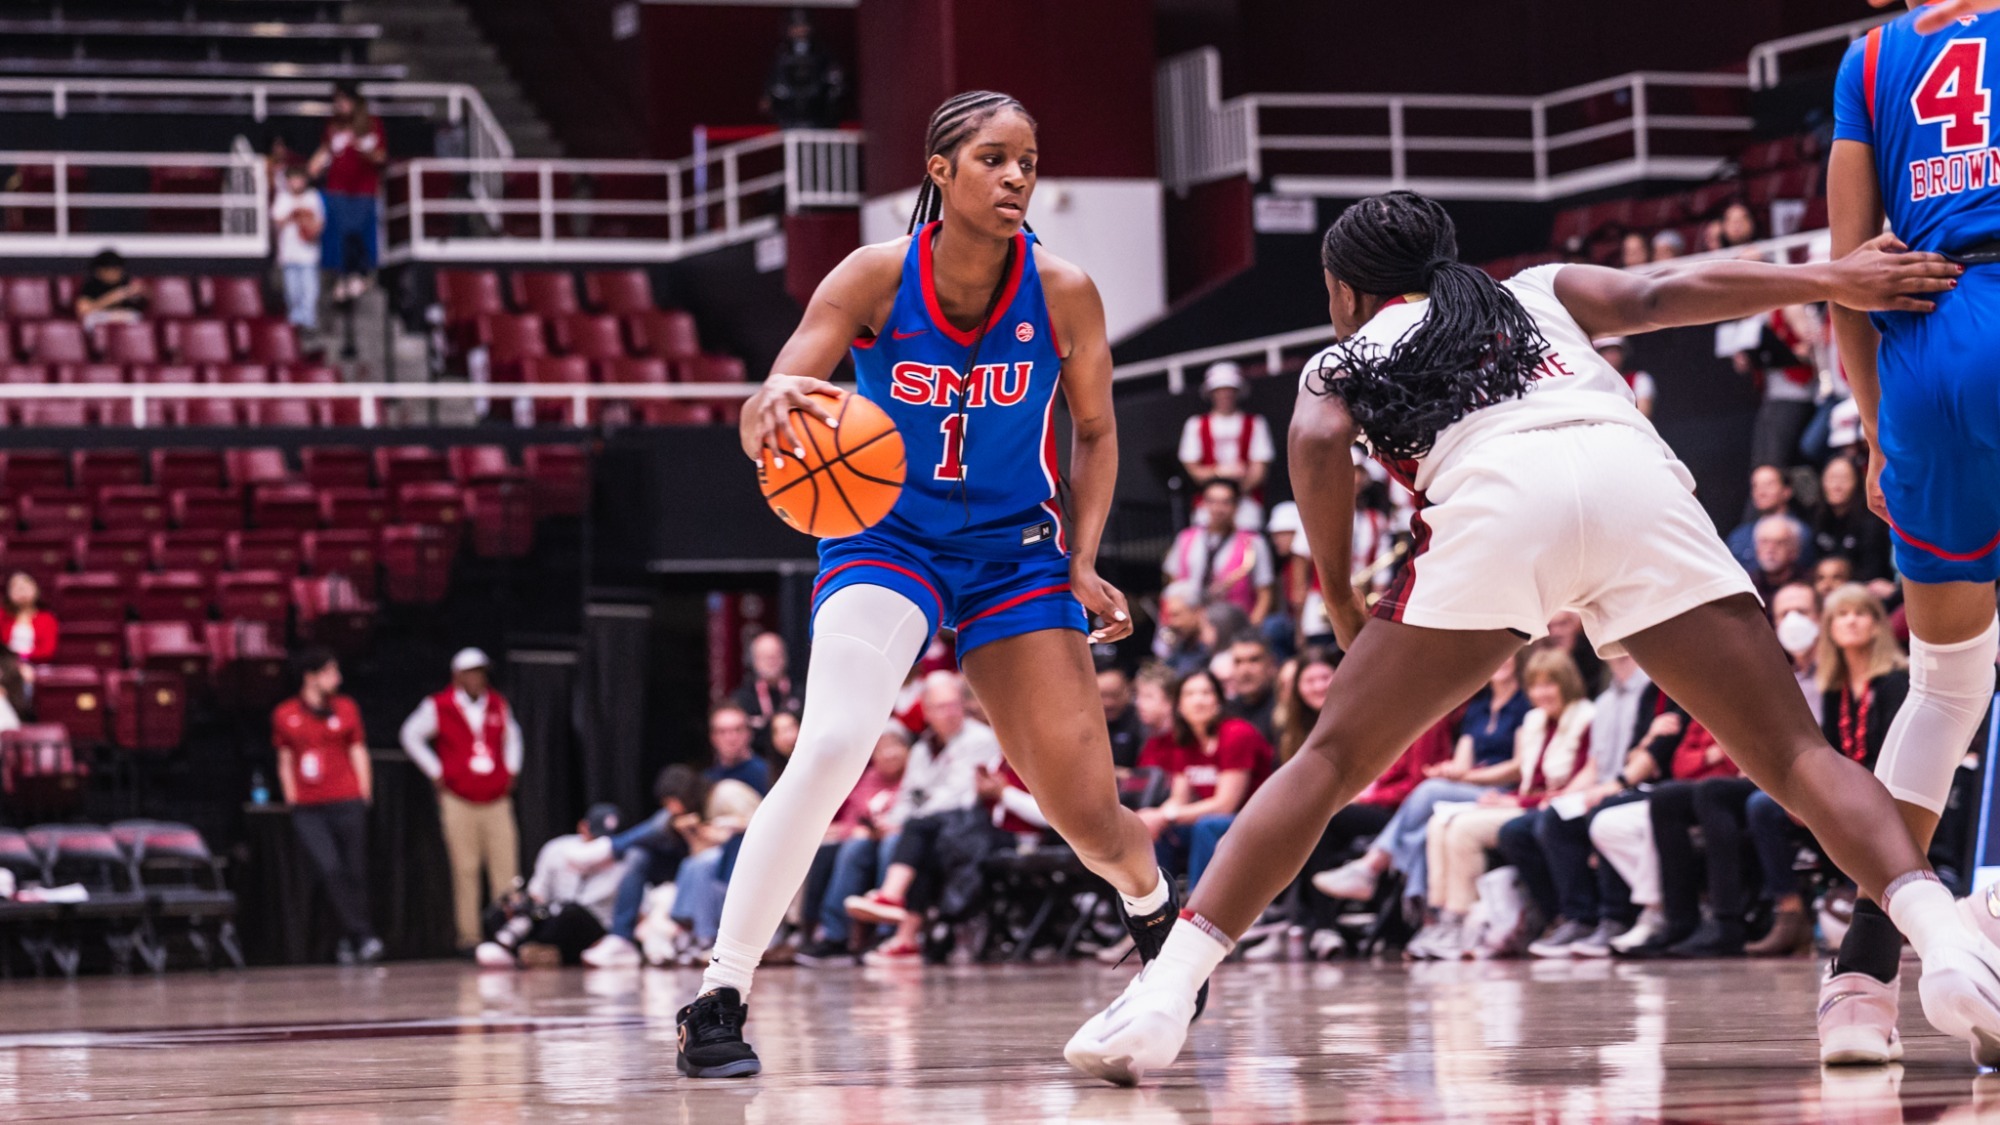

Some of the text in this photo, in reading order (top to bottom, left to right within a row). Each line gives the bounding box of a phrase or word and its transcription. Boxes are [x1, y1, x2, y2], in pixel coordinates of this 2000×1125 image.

[1910, 38, 1991, 153] 4
[1910, 147, 2000, 202] BROWN
[891, 361, 1033, 407] SMU
[934, 413, 968, 482] 1
